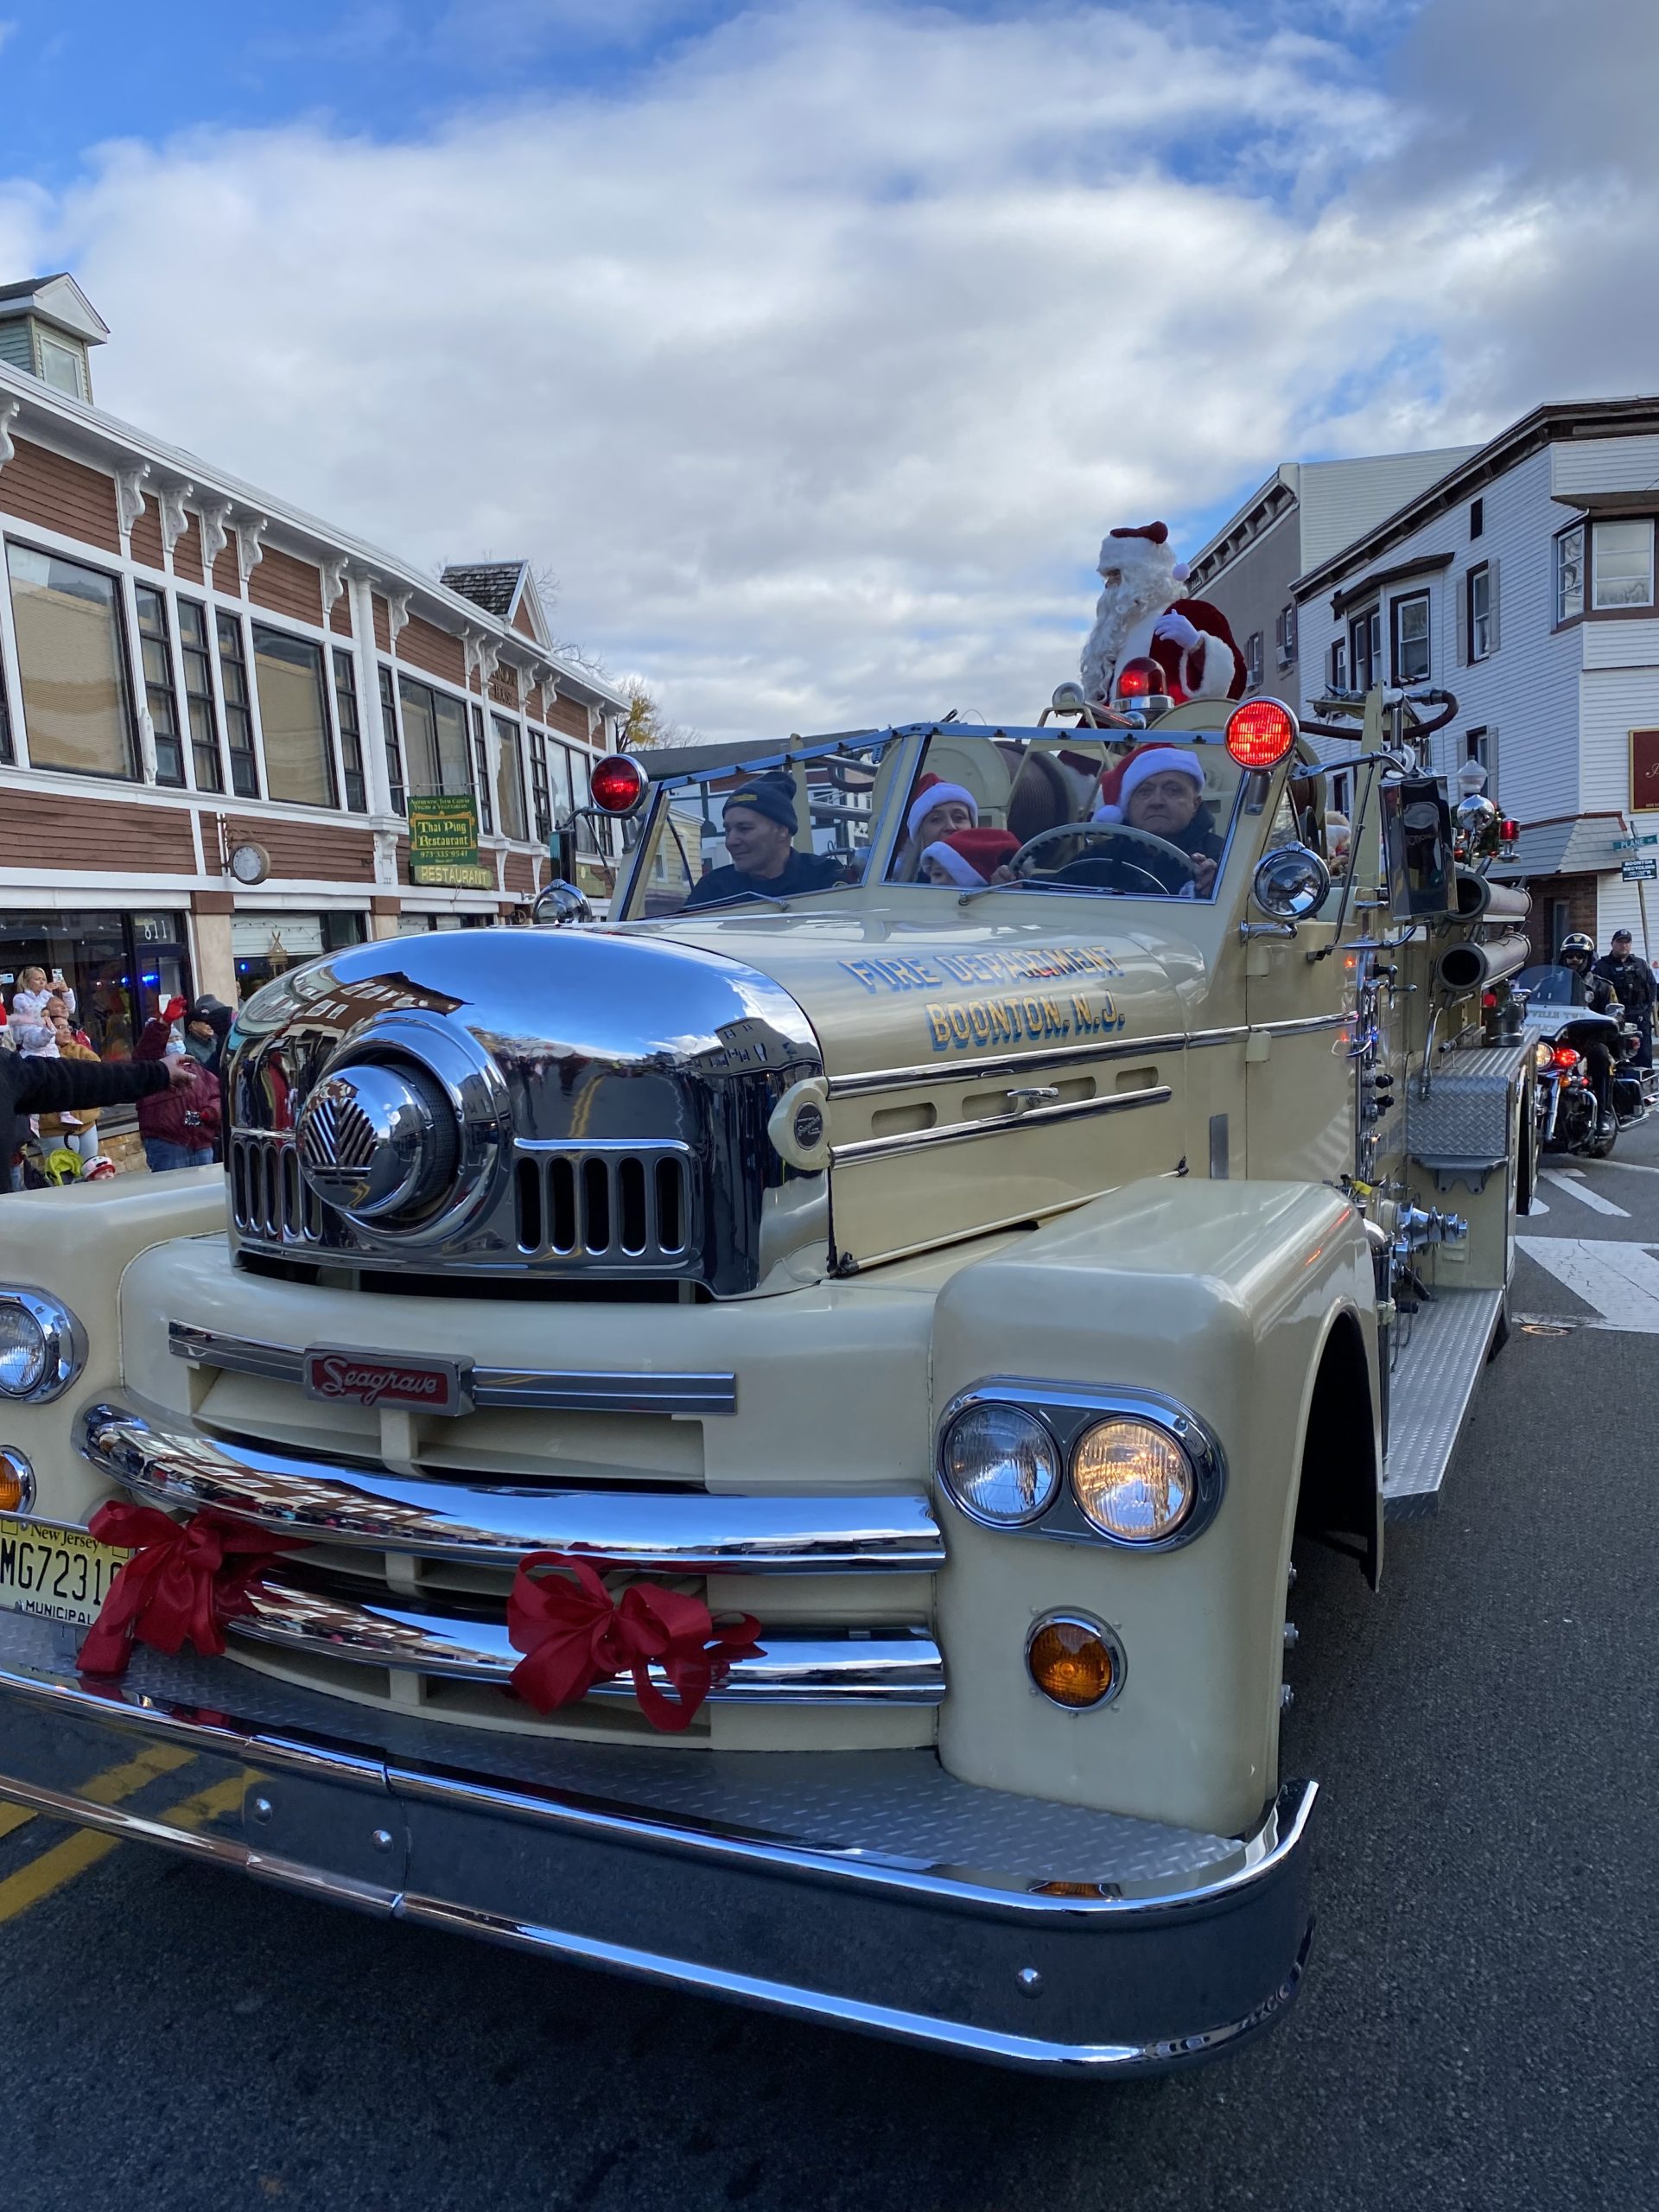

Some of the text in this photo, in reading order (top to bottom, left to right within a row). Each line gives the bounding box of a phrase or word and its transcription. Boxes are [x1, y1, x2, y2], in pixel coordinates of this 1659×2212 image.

[417, 821, 467, 835] Thai Ping
[417, 835, 468, 847] Restaurant
[1621, 838, 1644, 849] PLANE
[421, 866, 486, 885] RESTAURANT
[143, 918, 168, 940] 811
[838, 945, 1122, 992] FIRE DEPARTMENT
[1070, 989, 1126, 1035] N.J.
[323, 1357, 438, 1406] Seagrave
[30, 1524, 101, 1553] New Jersey
[26, 1599, 92, 1625] MUNICIPAL
